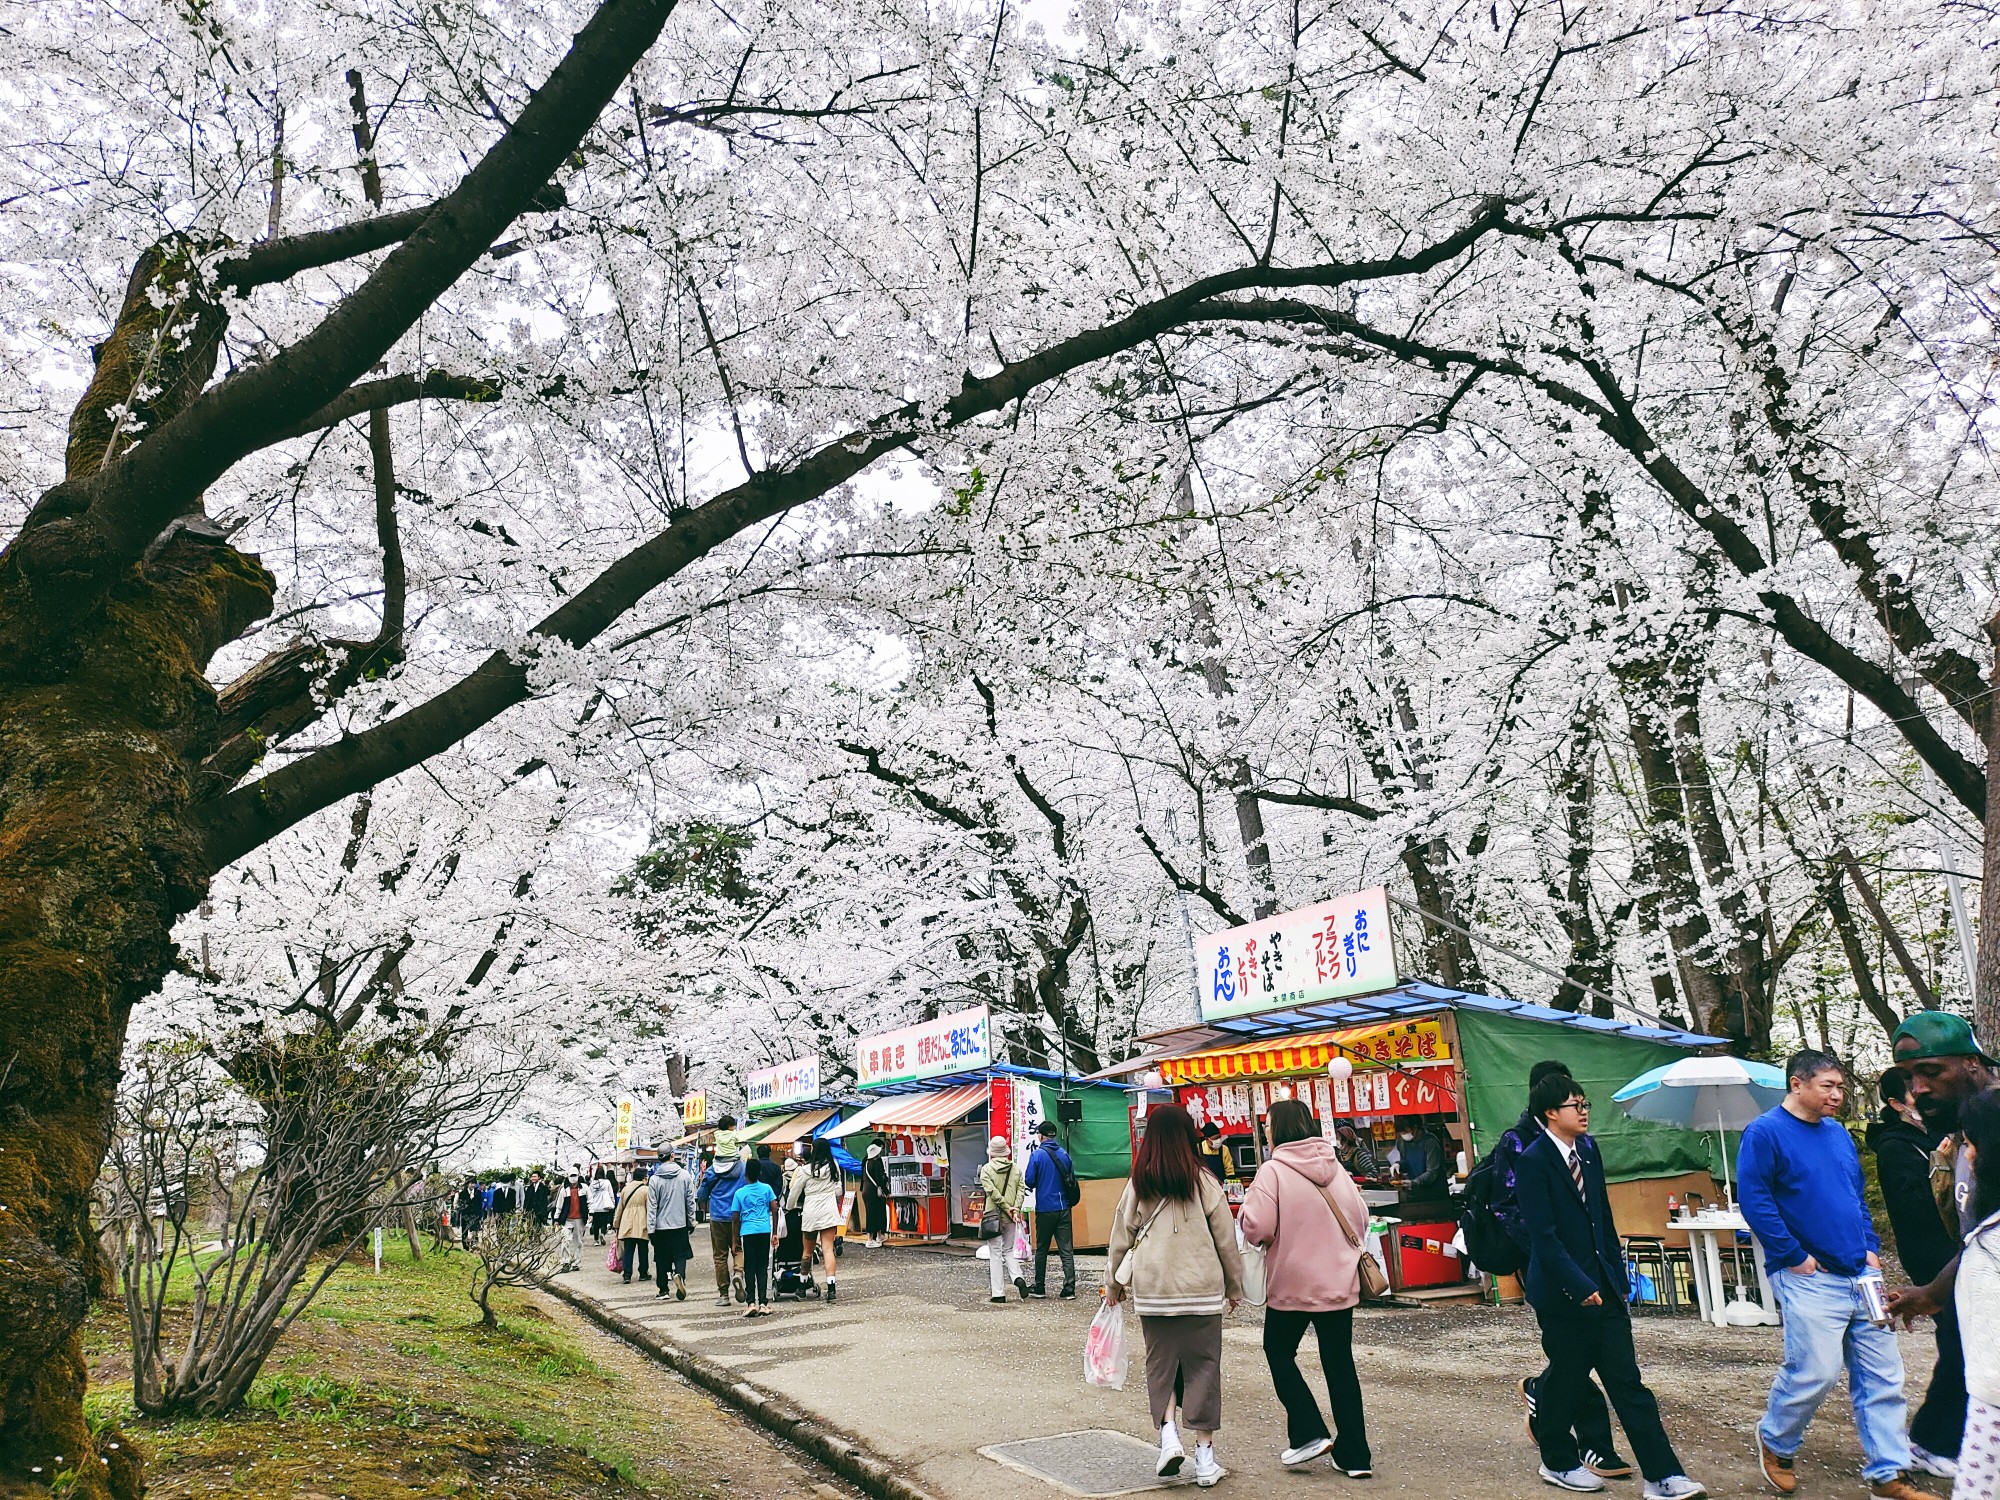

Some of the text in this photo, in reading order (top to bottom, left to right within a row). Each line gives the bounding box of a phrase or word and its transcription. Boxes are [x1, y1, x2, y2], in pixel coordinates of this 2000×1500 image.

[1245, 938, 1257, 979] やき
[1269, 931, 1282, 971] やき
[1312, 932, 1327, 984] フルト
[1323, 915, 1340, 980] フランク
[1214, 946, 1235, 1001] おでん
[1237, 957, 1248, 997] とり
[1261, 951, 1275, 992] そば
[869, 1044, 905, 1075] 串焼き
[917, 1030, 951, 1066] 花見だんご
[951, 1023, 980, 1059] 串だんご
[1353, 1031, 1436, 1063] やきそば
[782, 1067, 815, 1096] バナナチョコ
